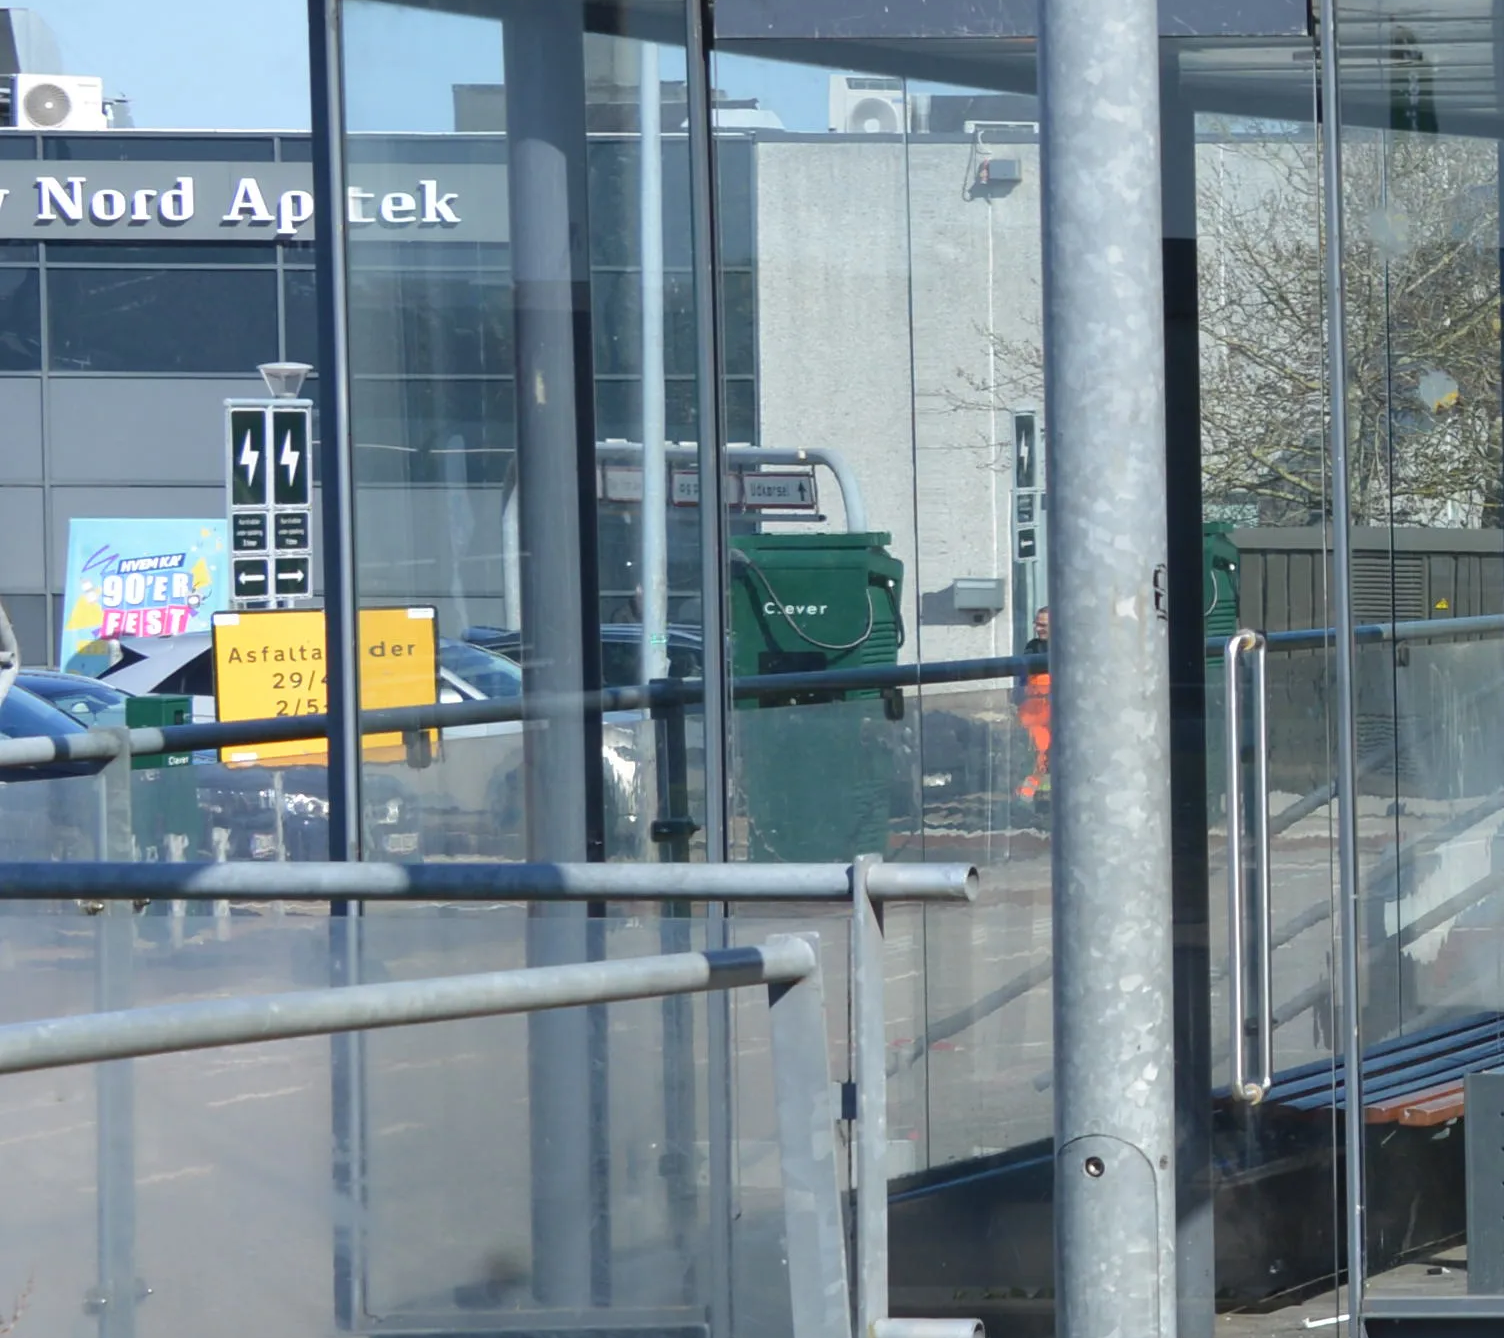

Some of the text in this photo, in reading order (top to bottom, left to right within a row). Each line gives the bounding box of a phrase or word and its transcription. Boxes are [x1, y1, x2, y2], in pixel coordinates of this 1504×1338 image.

[36, 177, 195, 221] Nord
[223, 177, 462, 234] Aptek
[763, 601, 828, 615] Cever
[105, 608, 185, 637] FEST
[272, 670, 328, 691] 29/
